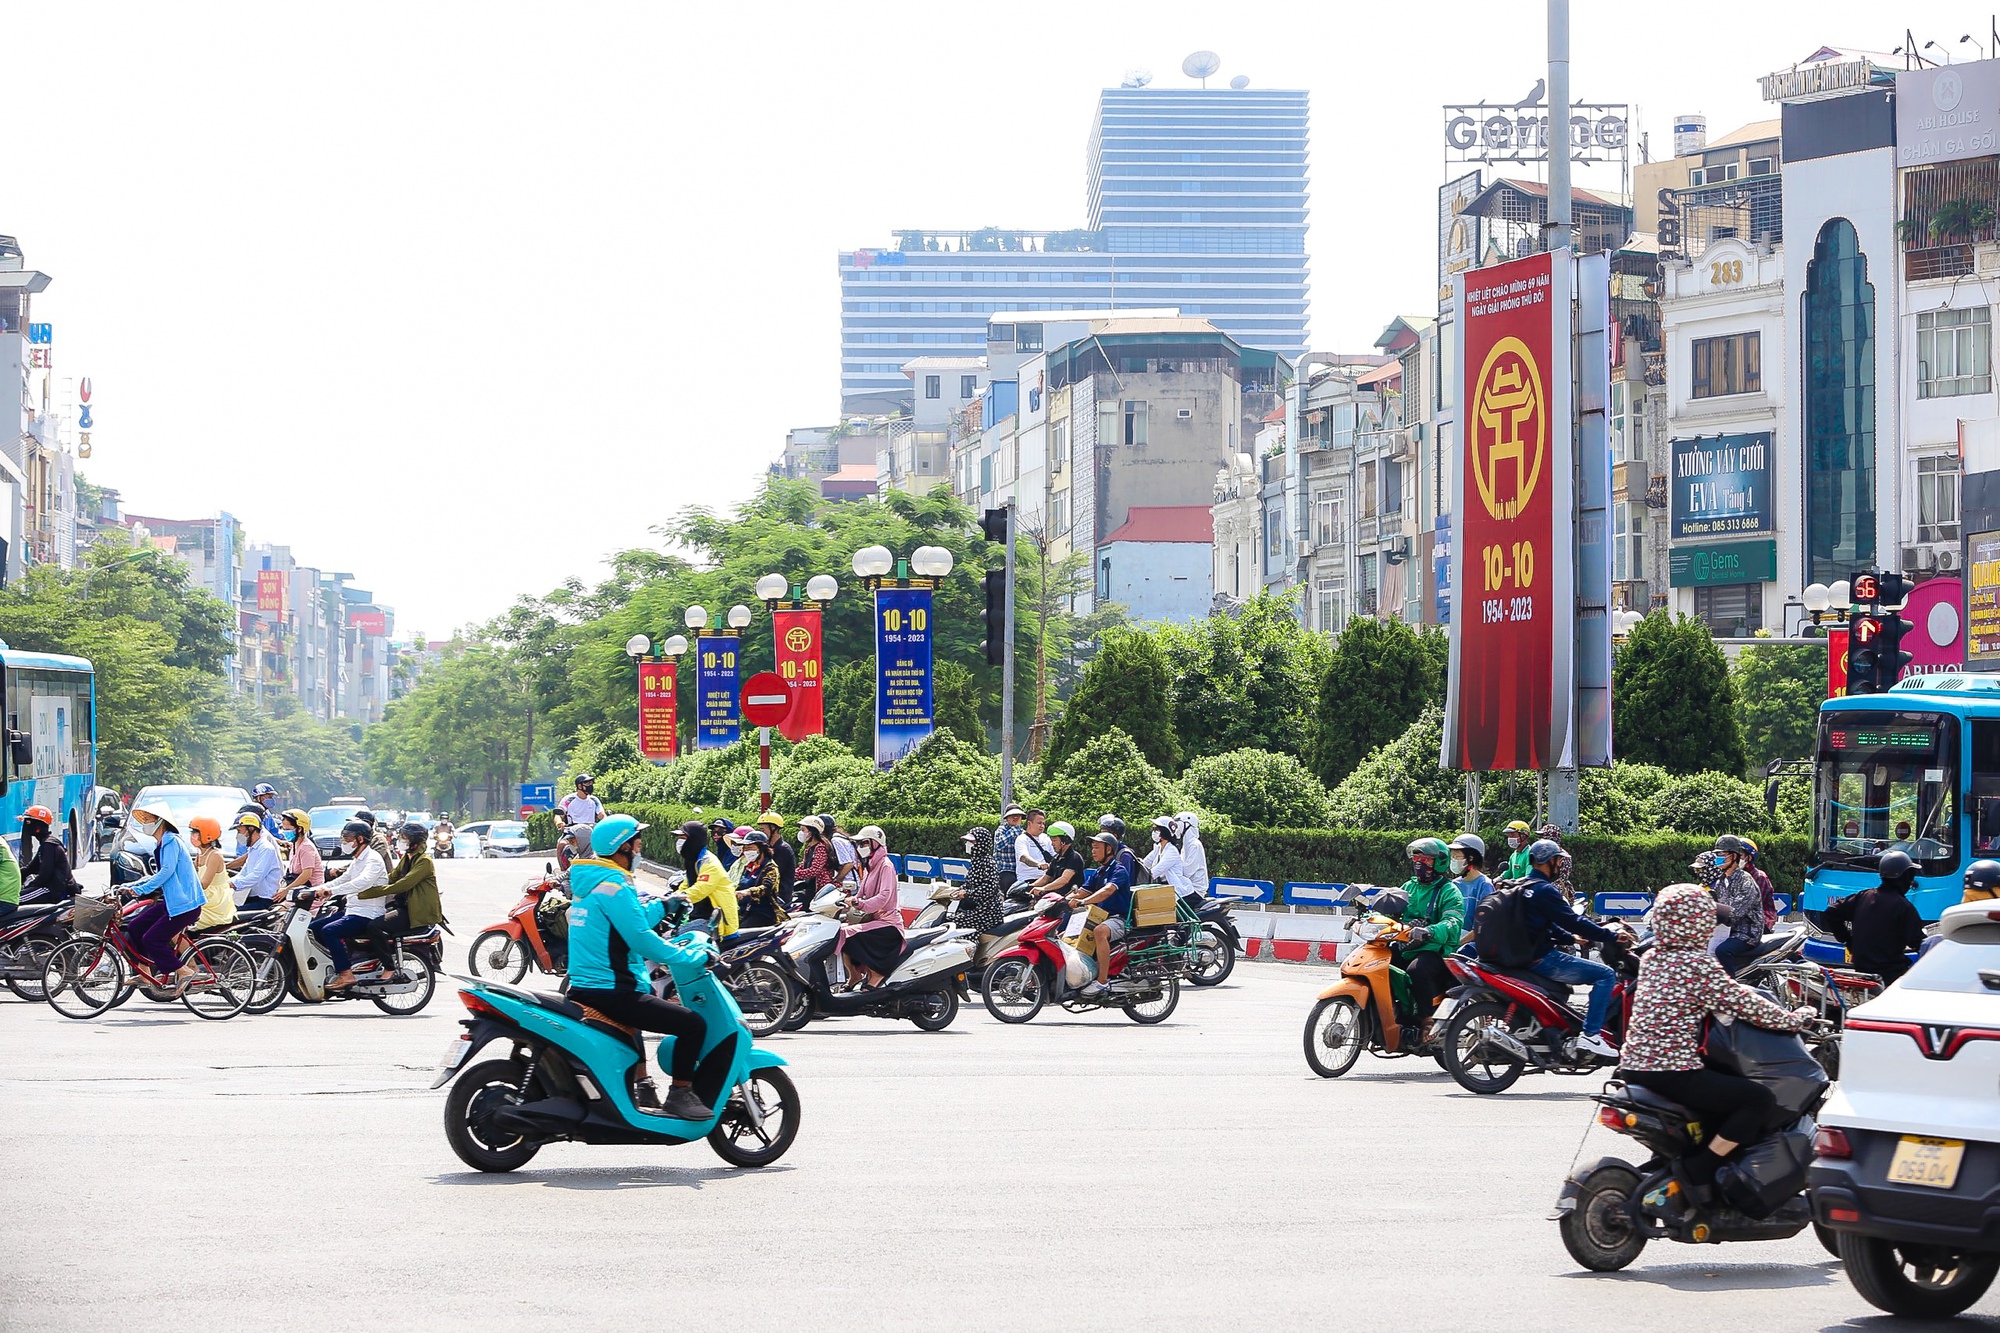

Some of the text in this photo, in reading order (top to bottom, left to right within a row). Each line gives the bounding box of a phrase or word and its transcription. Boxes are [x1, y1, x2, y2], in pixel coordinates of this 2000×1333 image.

[1917, 110, 1980, 132] ABI HOUSE
[1903, 128, 1996, 160] CHĂN GA GỐI
[1710, 259, 1744, 284] 283
[1466, 288, 1481, 304] NHIỆT
[1481, 286, 1491, 303] LIỆT
[1492, 283, 1508, 299] CHÀO
[1509, 280, 1527, 294] MỪNG
[1527, 279, 1536, 290] 69
[1536, 273, 1550, 288] NĂM
[1471, 302, 1488, 318] NGÀY
[1487, 300, 1500, 314] GIẢI
[1500, 296, 1520, 312] PHÓNG
[1521, 290, 1532, 307] THỦ
[1678, 439, 1765, 478] XƯỞNG VÁY CƯỚI
[1689, 482, 1753, 513] EVA Tầng 4
[1682, 517, 1759, 535] Hotline: 085 313 6868
[1482, 540, 1534, 591] 10-10
[1711, 551, 1740, 570] Gems
[1855, 579, 1876, 599] 56
[882, 608, 927, 631] 10-10
[1482, 599, 1503, 624] 1954
[1510, 596, 1533, 622] 2023
[885, 634, 901, 643] 1954
[907, 634, 925, 642] 2023
[702, 652, 735, 669] 10-10
[780, 659, 818, 679] 10-10
[643, 675, 673, 691] 10-10
